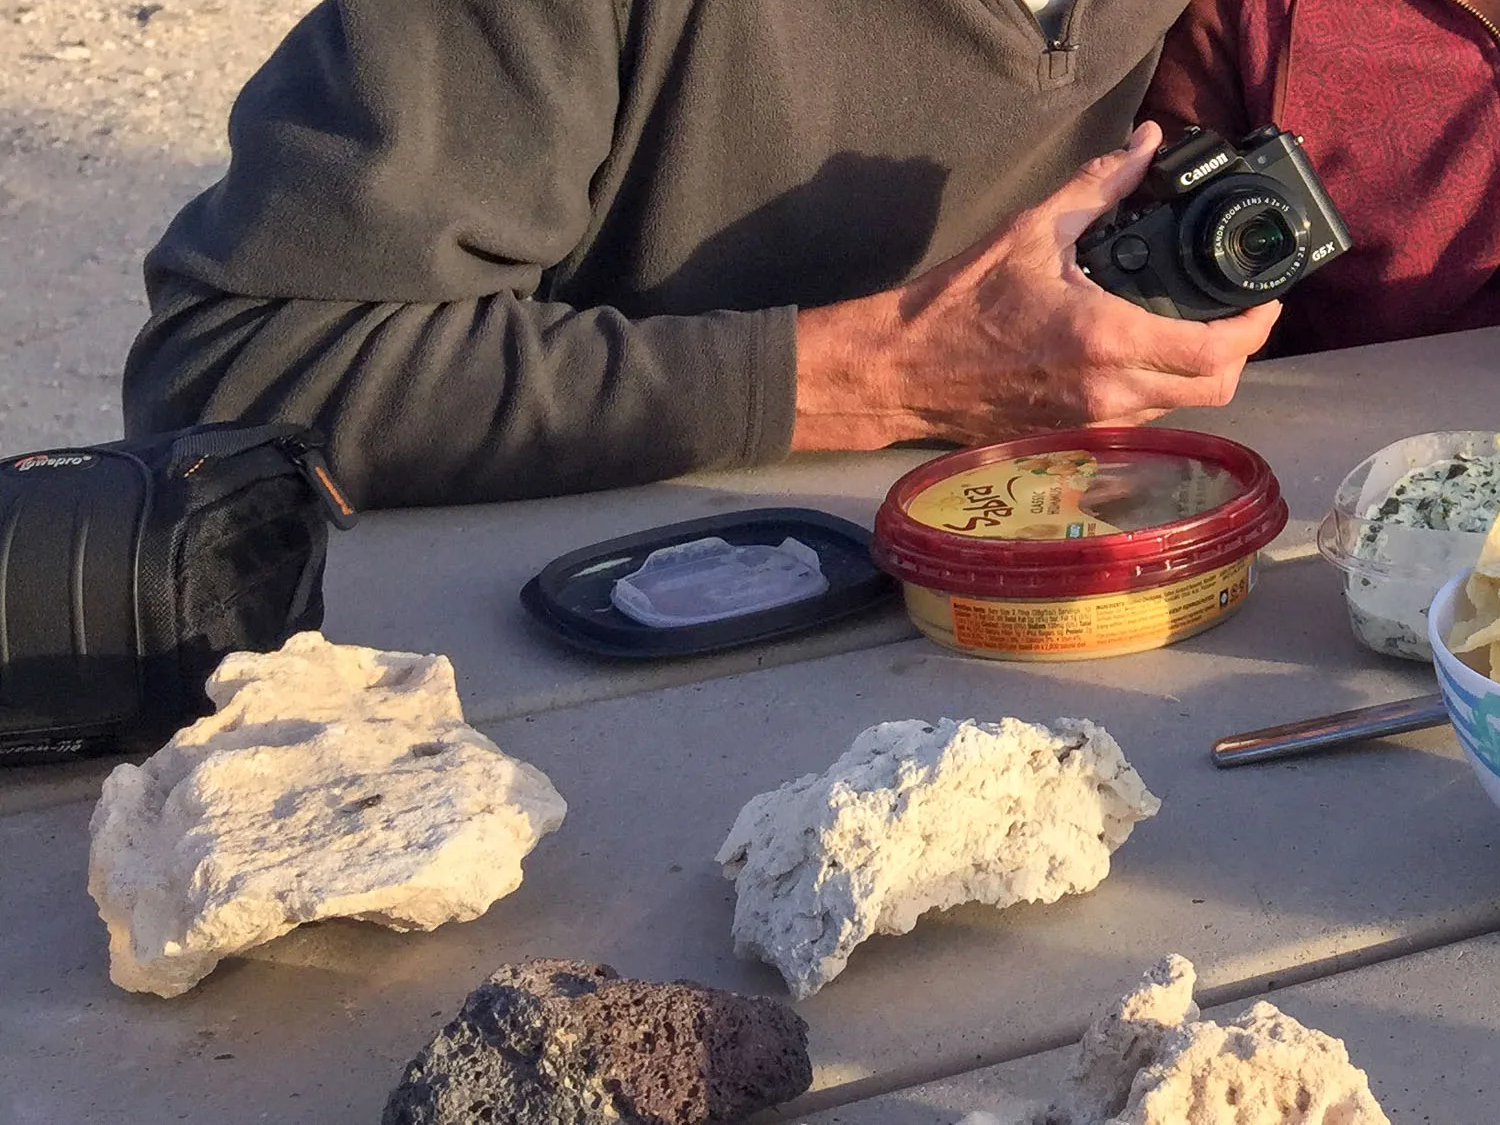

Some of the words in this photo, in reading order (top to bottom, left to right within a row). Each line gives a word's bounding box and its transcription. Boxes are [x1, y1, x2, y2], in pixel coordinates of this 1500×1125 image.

[1180, 152, 1229, 186] Canon
[1214, 225, 1226, 256] CANON
[1222, 203, 1242, 225] ZOOM
[1242, 196, 1262, 208] LENS
[14, 454, 83, 472] Lowepro
[942, 485, 1014, 532] Sabra
